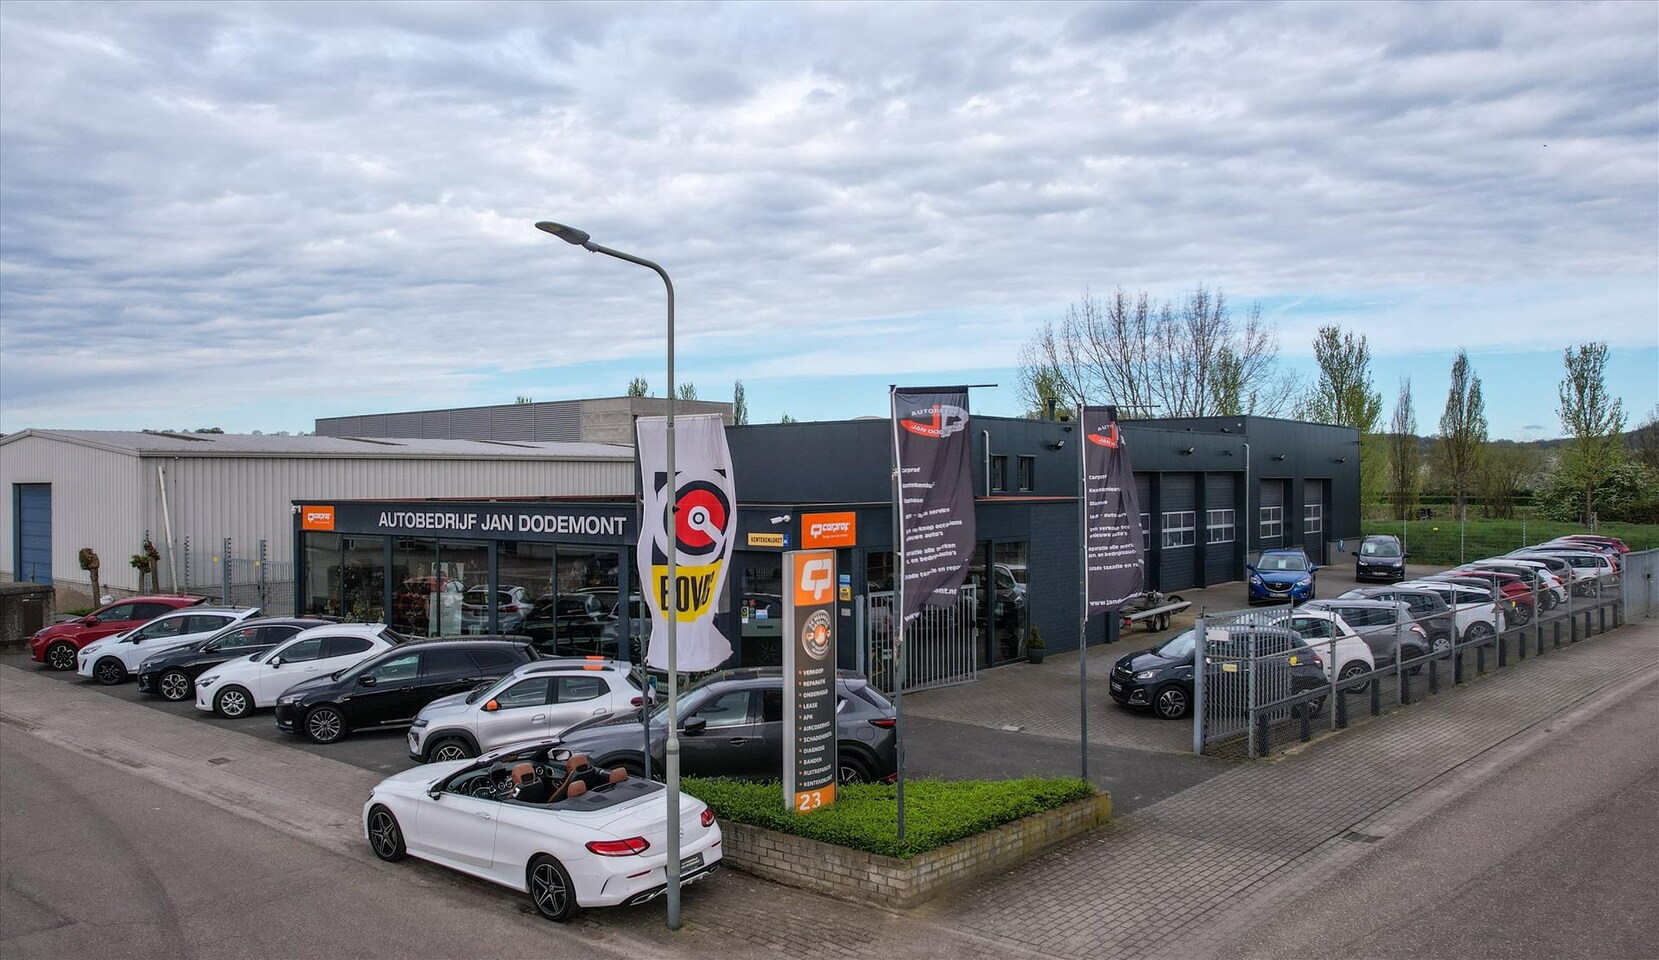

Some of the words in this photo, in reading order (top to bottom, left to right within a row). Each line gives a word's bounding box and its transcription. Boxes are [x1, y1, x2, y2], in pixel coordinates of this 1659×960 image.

[911, 424, 926, 433] JAN
[378, 511, 478, 531] AUTOBEDRIJF
[481, 514, 513, 531] JAN
[518, 515, 628, 535] DODEMONT
[803, 667, 824, 675] VERKOOP
[803, 702, 818, 710] LEASE
[799, 791, 821, 811] 23
